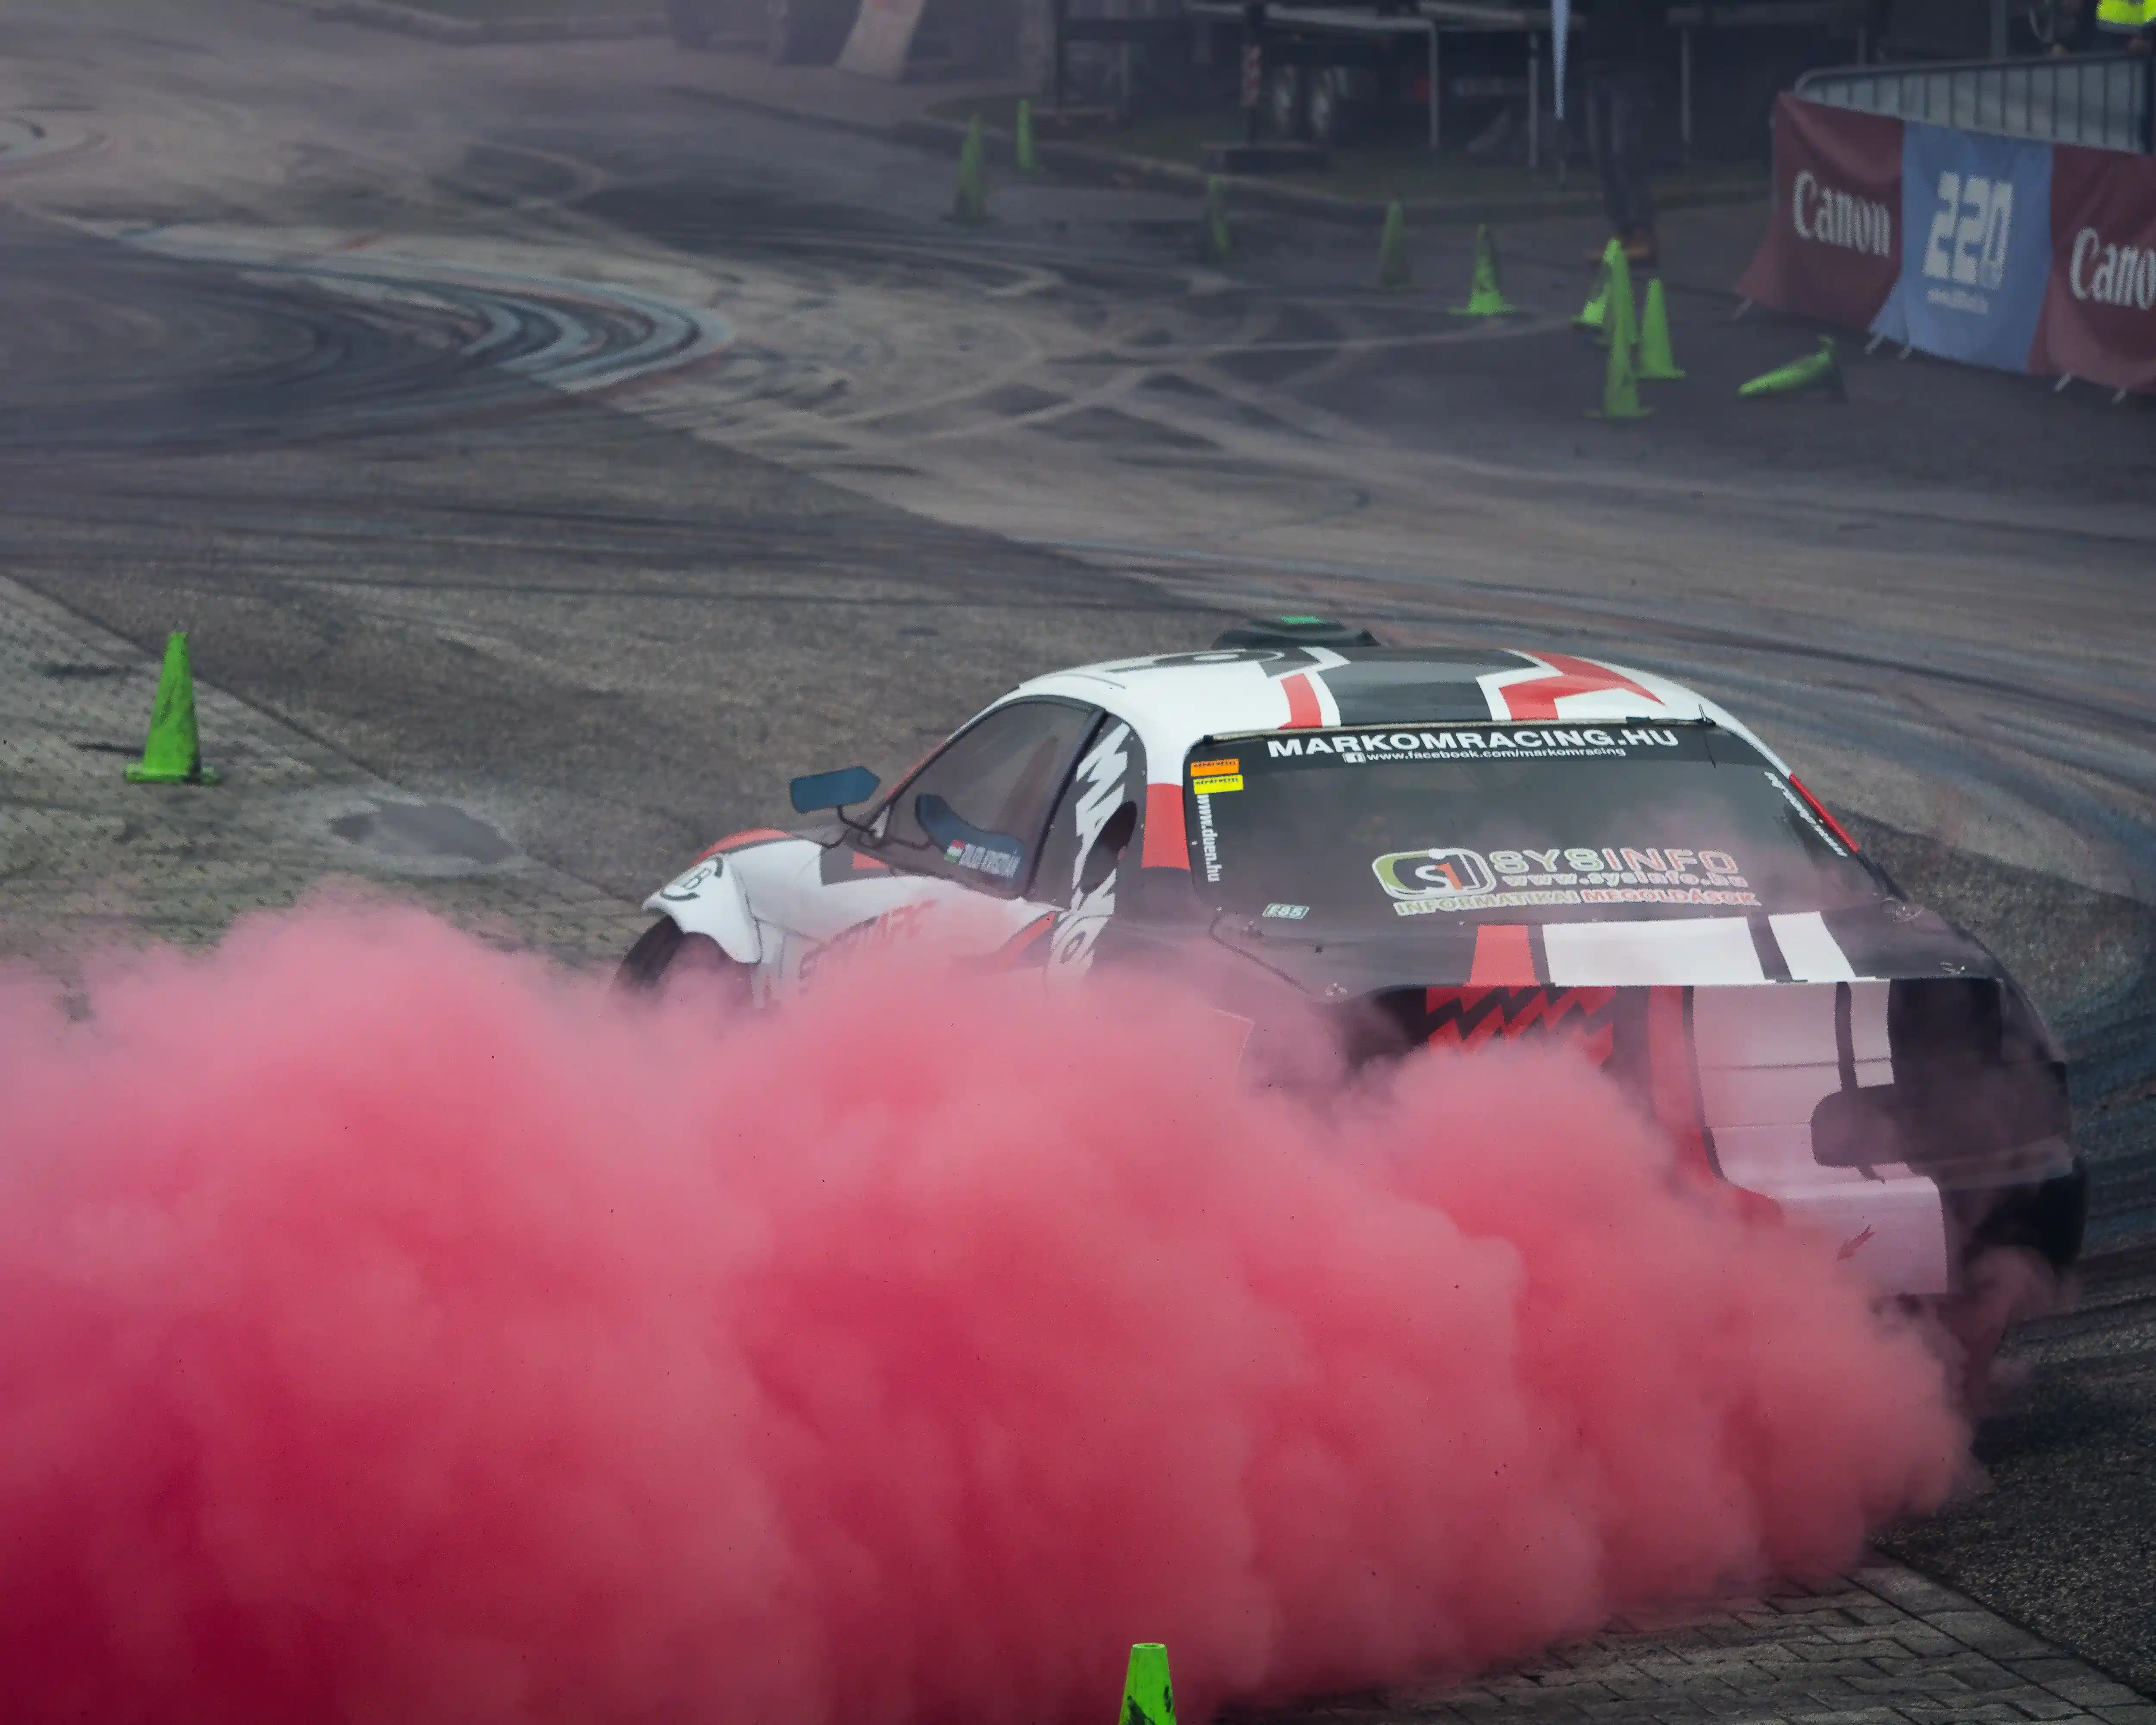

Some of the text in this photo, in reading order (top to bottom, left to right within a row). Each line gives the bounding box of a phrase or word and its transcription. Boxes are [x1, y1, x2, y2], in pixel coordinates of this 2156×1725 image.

[1793, 171, 1891, 257] Canon
[2070, 228, 2156, 310] Cano
[1267, 729, 1679, 758] MARKOMRACING.HU
[1366, 747, 1626, 762] www.facebook.com/markomracing
[1489, 848, 1739, 874] SYSINFO
